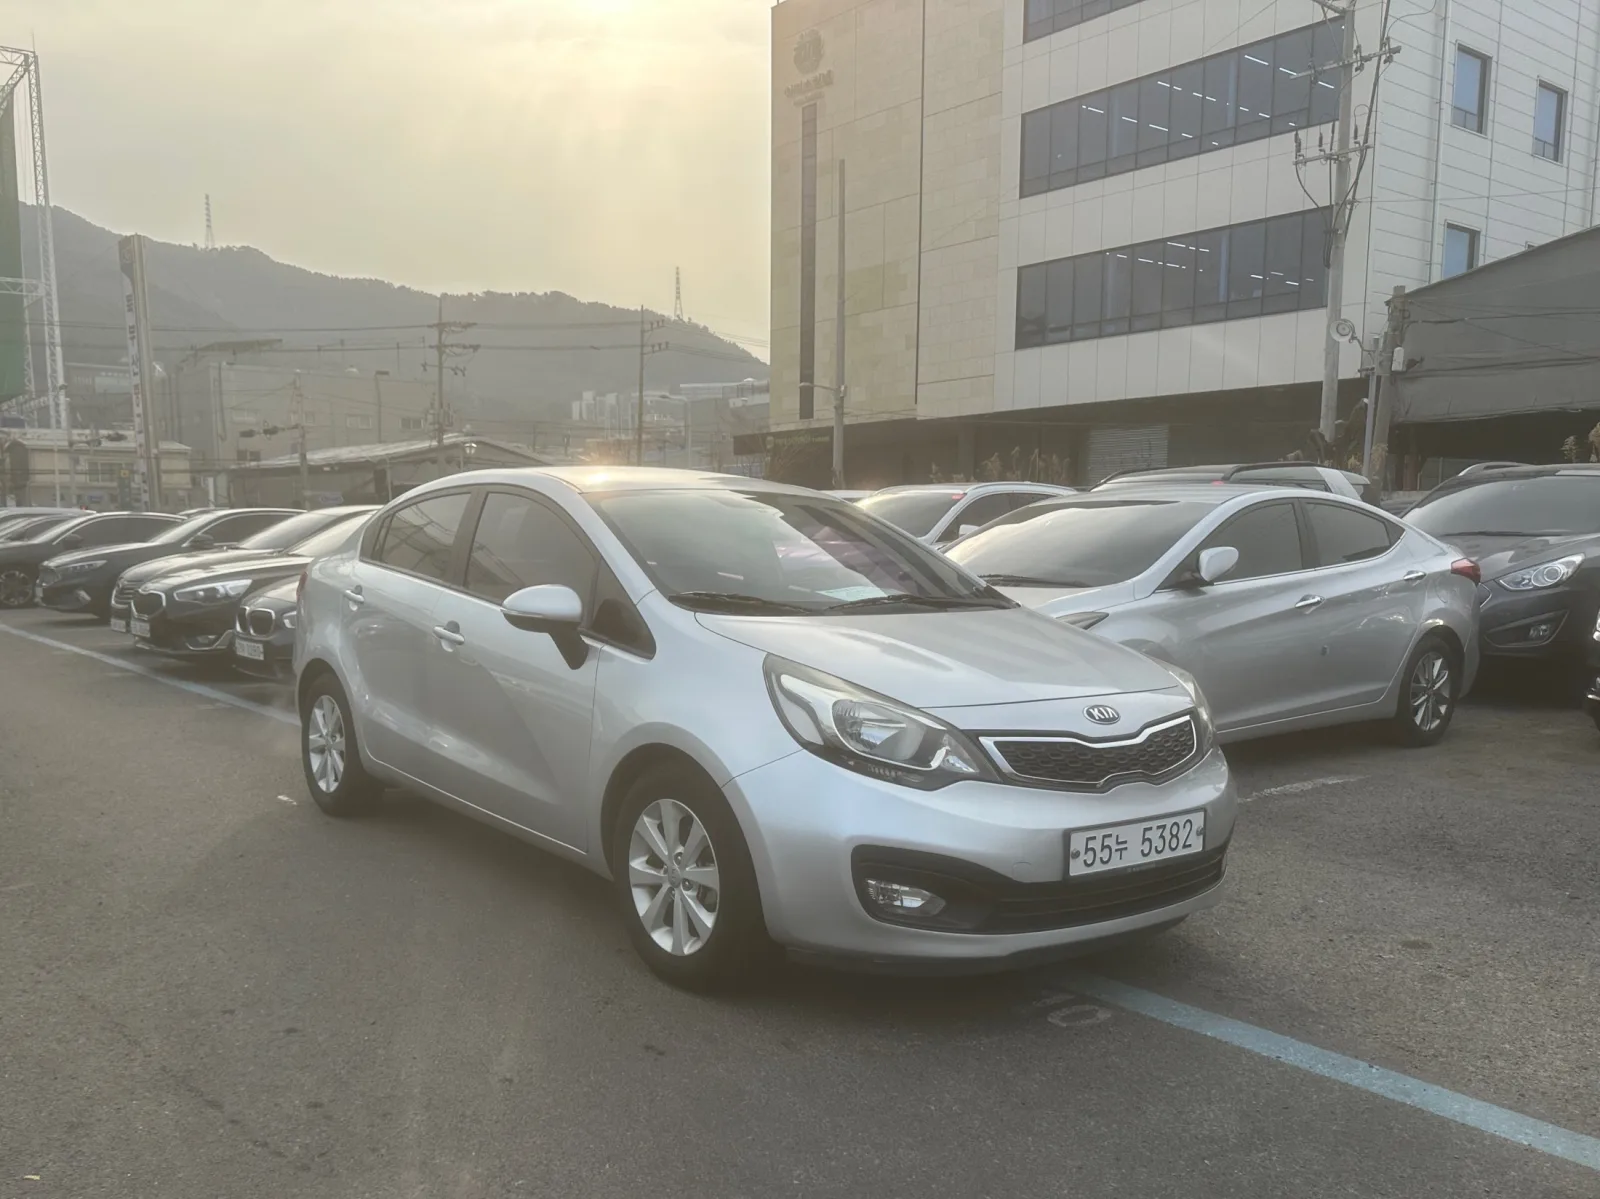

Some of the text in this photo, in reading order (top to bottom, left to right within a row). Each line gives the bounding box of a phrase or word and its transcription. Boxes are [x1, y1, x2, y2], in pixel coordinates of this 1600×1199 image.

[1089, 707, 1118, 720] KIA
[1083, 818, 1193, 868] 55누 5382
